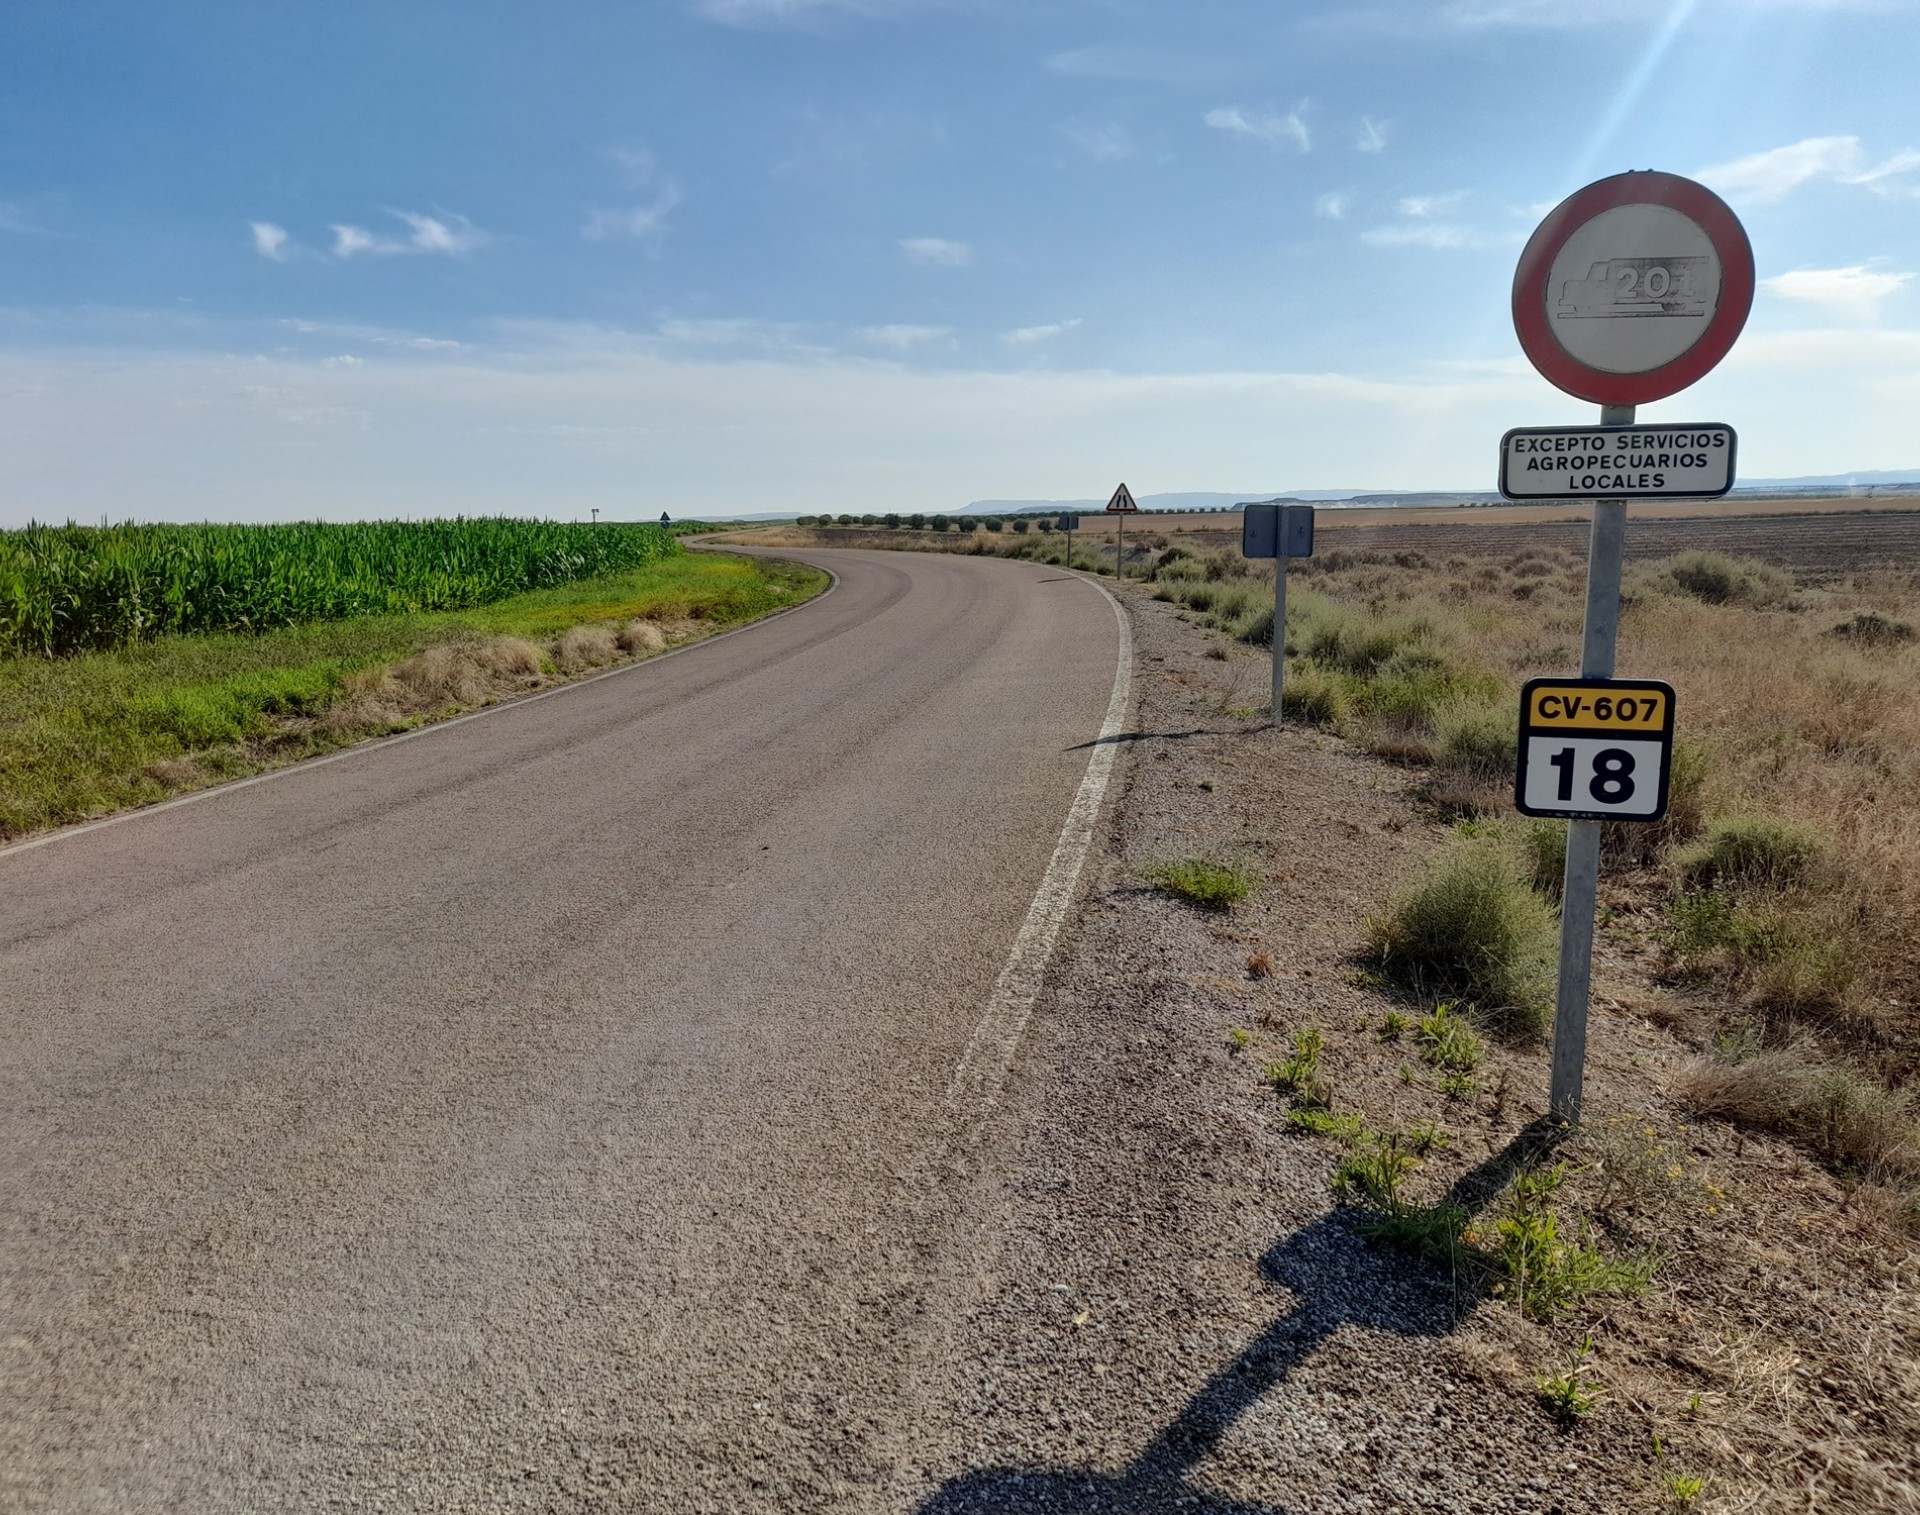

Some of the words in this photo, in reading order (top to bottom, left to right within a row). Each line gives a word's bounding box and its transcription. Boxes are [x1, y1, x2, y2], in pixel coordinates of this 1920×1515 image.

[1616, 266, 1671, 298] 20
[1515, 437, 1605, 453] EXCEPTO
[1616, 433, 1725, 450] SERVICIOS
[1527, 453, 1708, 471] AGROPECUARIOS
[1569, 473, 1665, 490] LOCALES
[1538, 695, 1658, 722] CV-607
[1550, 747, 1636, 805] 18
